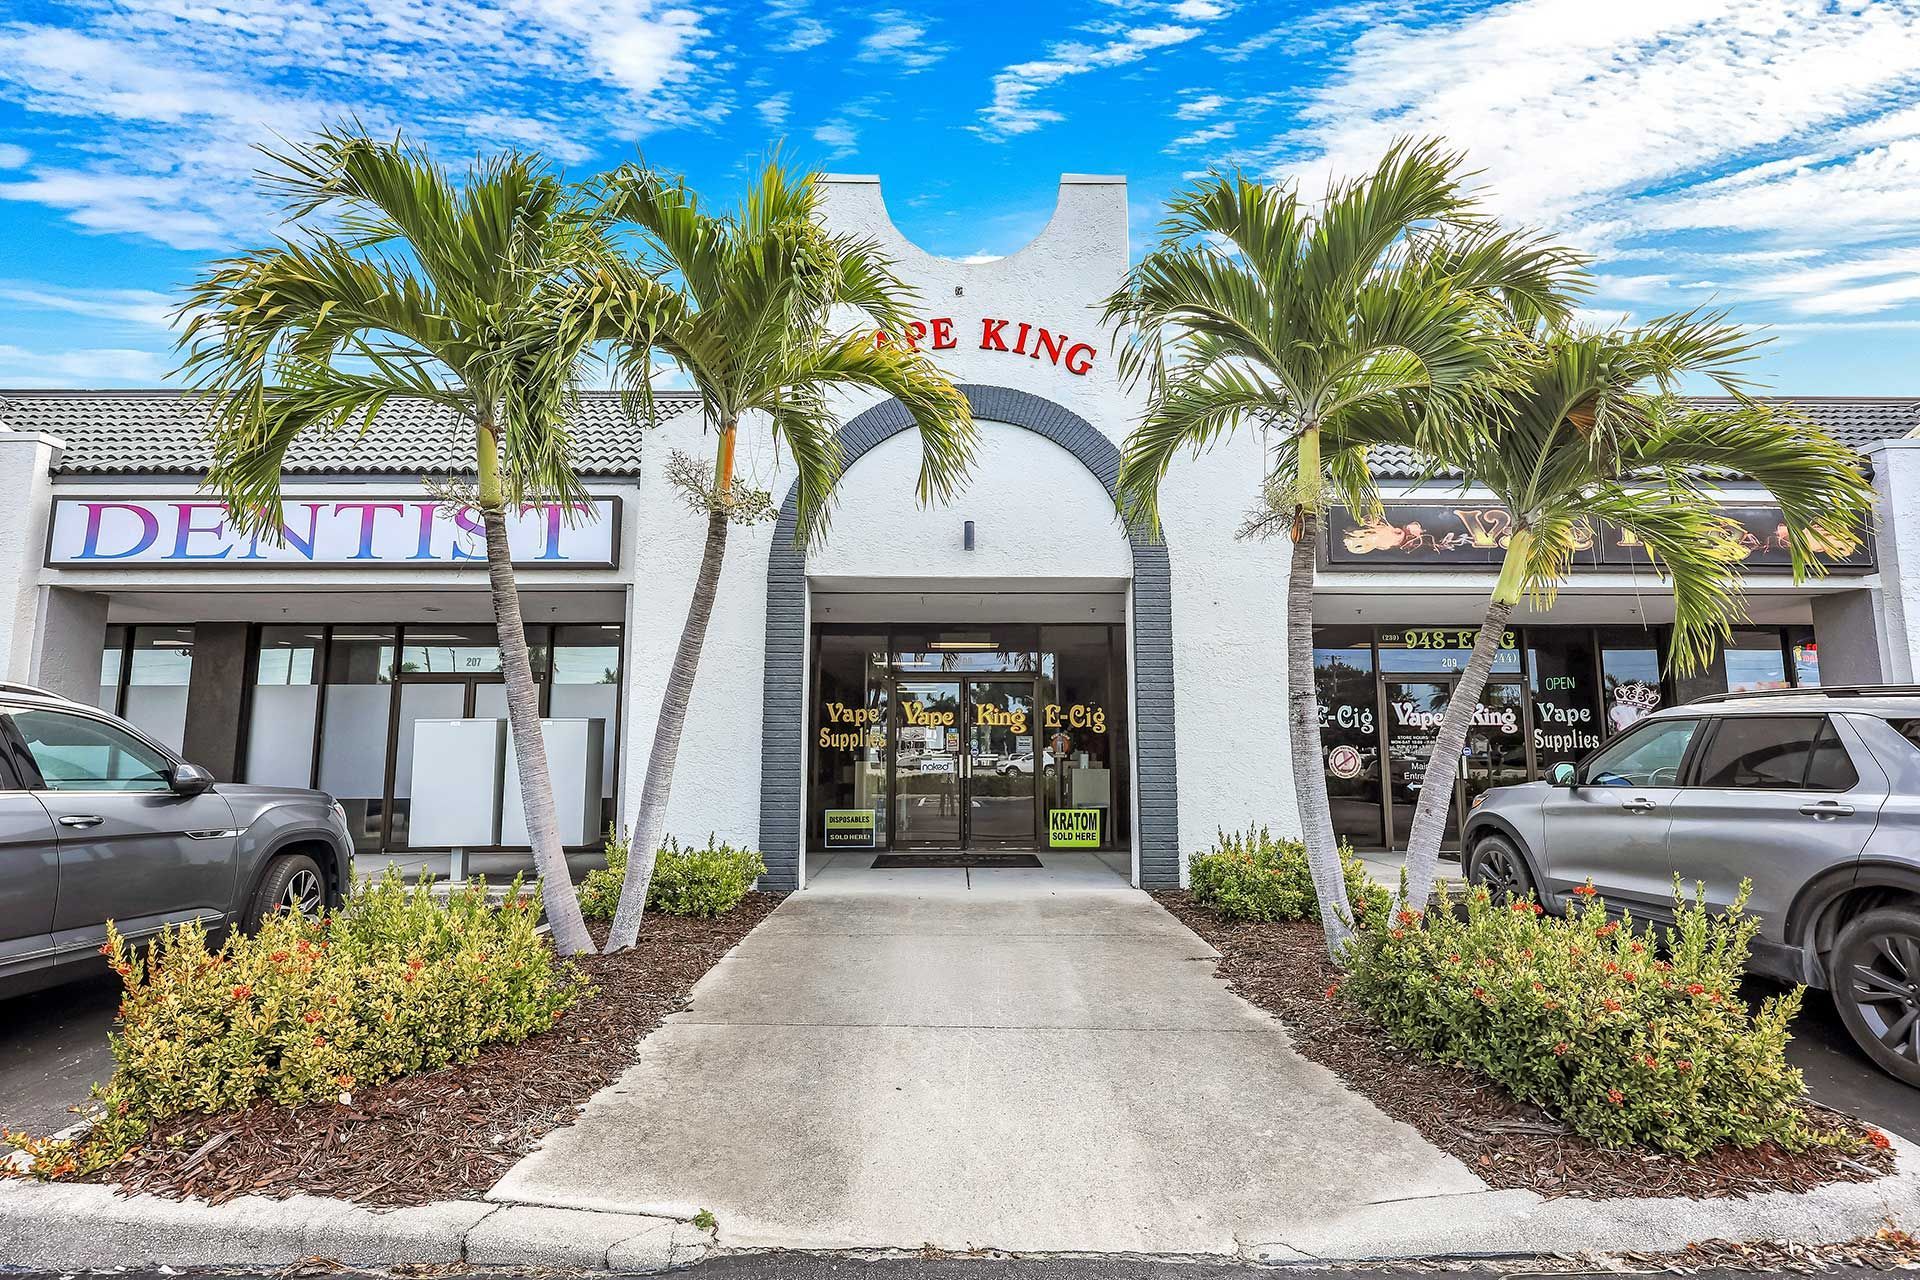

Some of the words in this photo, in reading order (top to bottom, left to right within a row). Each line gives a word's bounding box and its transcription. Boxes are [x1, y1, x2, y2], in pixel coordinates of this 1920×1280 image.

[860, 318, 957, 353] APE
[979, 319, 1097, 375] KING
[70, 503, 589, 560] DENTIST
[1405, 631, 1515, 649] 948-EG
[466, 657, 481, 667] 207
[1441, 658, 1457, 668] 209
[1545, 677, 1576, 690] OPEN
[826, 702, 880, 727] Vape
[902, 701, 955, 729] Vape
[976, 703, 1027, 733] King
[1044, 704, 1107, 734] E-Cig
[1316, 704, 1374, 734] E-Cig
[1391, 702, 1444, 731] Vape
[1537, 702, 1592, 727] Vape
[819, 727, 887, 752] Supplies
[1534, 728, 1600, 753] Supplies
[1403, 772, 1425, 781] Entra
[829, 815, 870, 824] DISPOSABLES
[1052, 812, 1097, 831] KRATOM
[1052, 832, 1073, 841] SOLD
[1075, 832, 1097, 841] HERE
